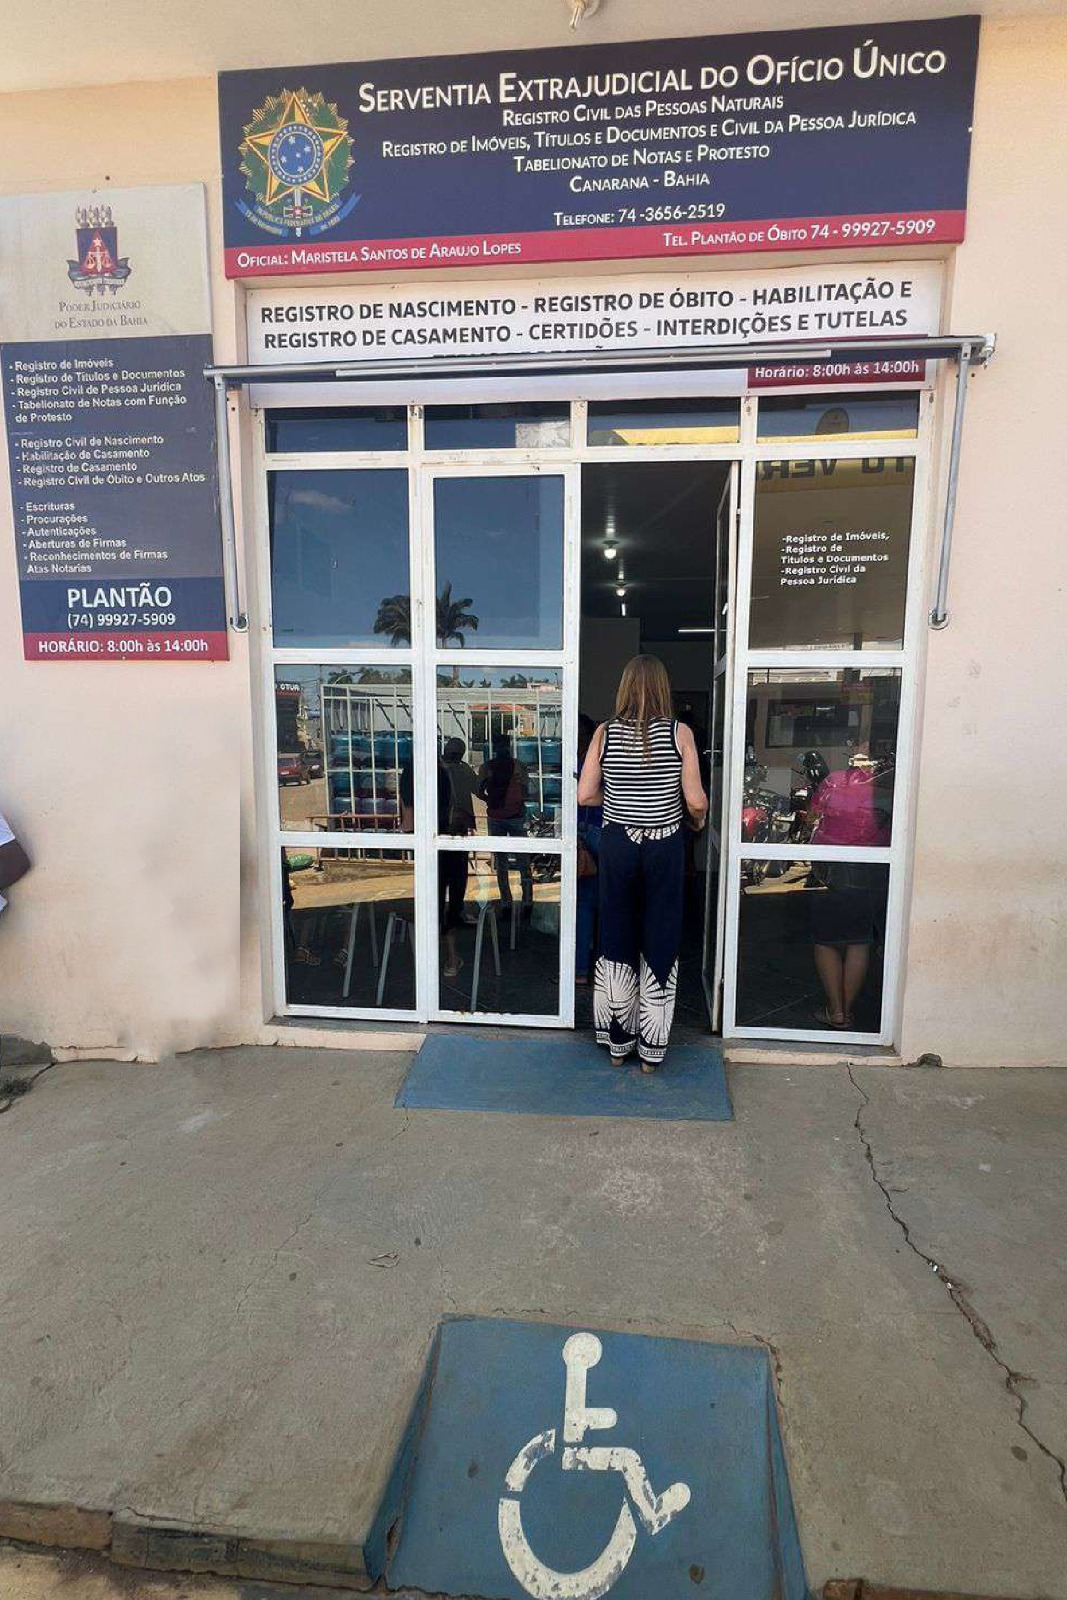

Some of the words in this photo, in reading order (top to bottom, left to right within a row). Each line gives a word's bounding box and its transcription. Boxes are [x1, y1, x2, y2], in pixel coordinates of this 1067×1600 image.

[261, 304, 353, 324] REGISTRO
[359, 303, 383, 319] DE
[389, 299, 516, 319] NASCIMENTO
[534, 293, 633, 313] REGISTRO
[639, 292, 664, 309] DE
[669, 288, 734, 308] ÓBITO
[752, 277, 894, 306] HABILITAÇÃO
[900, 281, 912, 298] E
[264, 330, 356, 349] REGISTRO
[362, 330, 386, 346] DE
[391, 325, 511, 345] CASAMENTO
[529, 318, 638, 340] CERTIDÕES
[657, 312, 792, 338] INTERDIÇÕES
[798, 314, 808, 330] E
[814, 309, 908, 328] TUTELAS
[15, 361, 57, 373] Registro
[60, 360, 71, 369] de
[74, 358, 114, 369] Imóveis
[755, 367, 809, 378] Horário:
[812, 364, 851, 377] 8:00h
[854, 363, 869, 374] às
[874, 361, 919, 373] 14:00h
[16, 374, 58, 386] Registro
[61, 373, 73, 382] de
[113, 373, 118, 381] e
[121, 369, 186, 381] Documentos
[17, 387, 59, 399] Registro
[62, 385, 84, 395] Civil
[86, 385, 98, 394] de
[101, 384, 137, 394] Pessoa
[18, 399, 75, 410] Tabelionato
[78, 398, 90, 408] de
[92, 397, 122, 407] Notas
[124, 397, 146, 406] com
[149, 395, 187, 407] Função
[15, 413, 27, 423] de
[31, 412, 72, 422] Protesto
[21, 438, 62, 450] Registro
[65, 437, 87, 447] Civil
[89, 437, 101, 446] de
[104, 435, 164, 446] Nascimento
[22, 451, 76, 462] Habilitação
[79, 450, 91, 460] de
[94, 449, 149, 459] Casamento
[23, 464, 64, 476] Registro
[67, 463, 79, 473] de
[81, 461, 137, 472] Casamento
[23, 477, 65, 489] Registro
[68, 475, 90, 485] Civil
[92, 475, 104, 485] de
[107, 473, 134, 484] Óbito
[137, 476, 142, 484] e
[145, 473, 180, 483] Outros
[182, 472, 206, 482] Atos
[26, 502, 75, 512] Escrituras
[27, 514, 88, 525] Procurações
[29, 539, 76, 549] Aberturas
[78, 539, 91, 548] de
[93, 538, 127, 548] Firmas
[830, 533, 843, 541] de
[845, 531, 890, 541] Imóveis,
[30, 551, 117, 562] Reconhecimentos
[120, 550, 131, 559] de
[134, 549, 168, 560] Firmas
[830, 544, 843, 552] de
[826, 554, 889, 563] Documentos
[51, 563, 92, 573] Notarias
[829, 564, 851, 573] Civil
[853, 564, 866, 573] da
[68, 582, 172, 608] PLANTÃO
[67, 613, 94, 629] (74)
[97, 613, 176, 627] 99927-5909
[38, 638, 104, 653] HORÁRIO:
[107, 640, 142, 652] 8:00h
[147, 640, 161, 651] às
[164, 639, 208, 652] 14:00h
